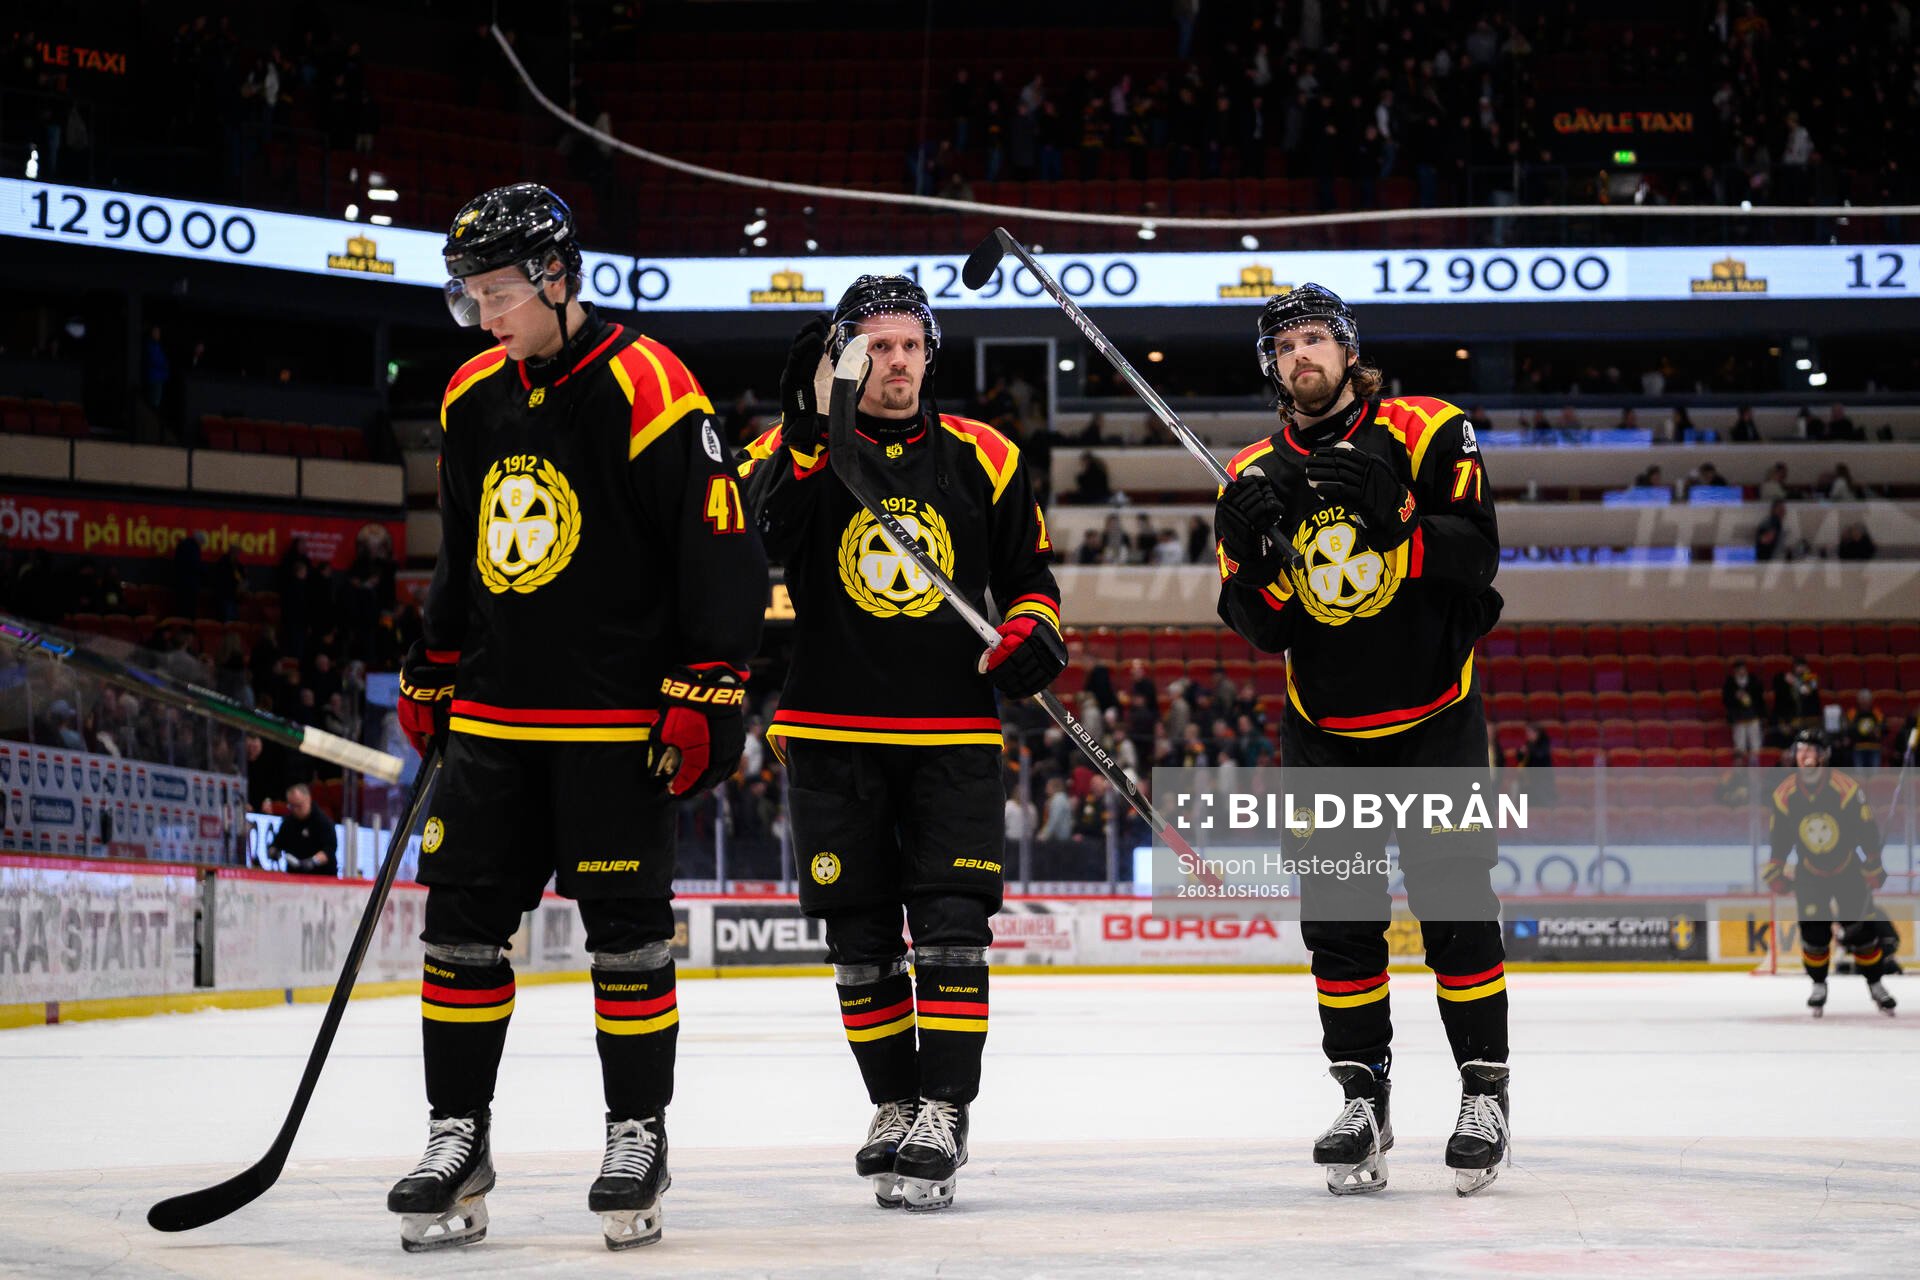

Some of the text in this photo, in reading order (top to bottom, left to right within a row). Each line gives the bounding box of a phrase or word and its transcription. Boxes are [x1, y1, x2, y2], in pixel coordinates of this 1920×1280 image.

[37, 41, 126, 76] LE TAXI
[1636, 112, 1693, 132] TAXI
[30, 190, 88, 235] 12
[1375, 258, 1431, 294] 12
[503, 454, 538, 474] 1912
[704, 474, 746, 534] 41
[881, 497, 918, 513] 1912
[1312, 505, 1346, 527] 1912
[84, 513, 120, 549] på
[882, 513, 926, 558] FLYLITE
[660, 677, 746, 705] BAUER
[1071, 722, 1115, 770] BAUER
[576, 860, 640, 872] BAUER
[953, 858, 1001, 874] BAUER
[61, 908, 168, 973] START
[1103, 913, 1279, 941] BORGA
[606, 983, 648, 991] BAUER
